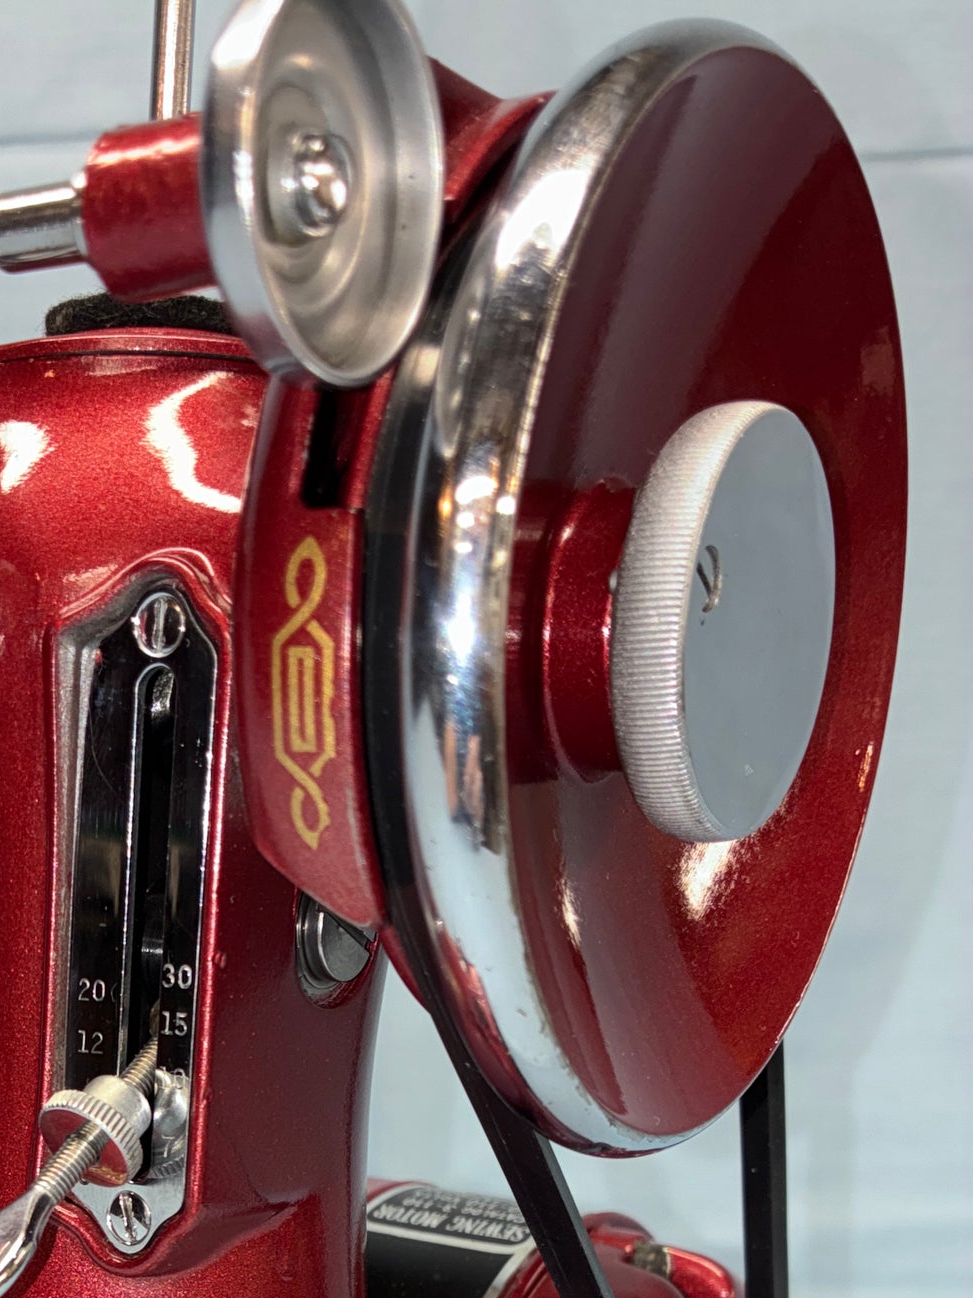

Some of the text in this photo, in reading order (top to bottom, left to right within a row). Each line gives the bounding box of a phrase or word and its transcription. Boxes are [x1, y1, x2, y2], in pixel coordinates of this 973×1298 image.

[162, 963, 192, 989] 30
[78, 978, 106, 1002] 20
[161, 1010, 188, 1036] 15
[77, 1029, 103, 1055] 12
[373, 1203, 530, 1243] SEWING MOTOR
